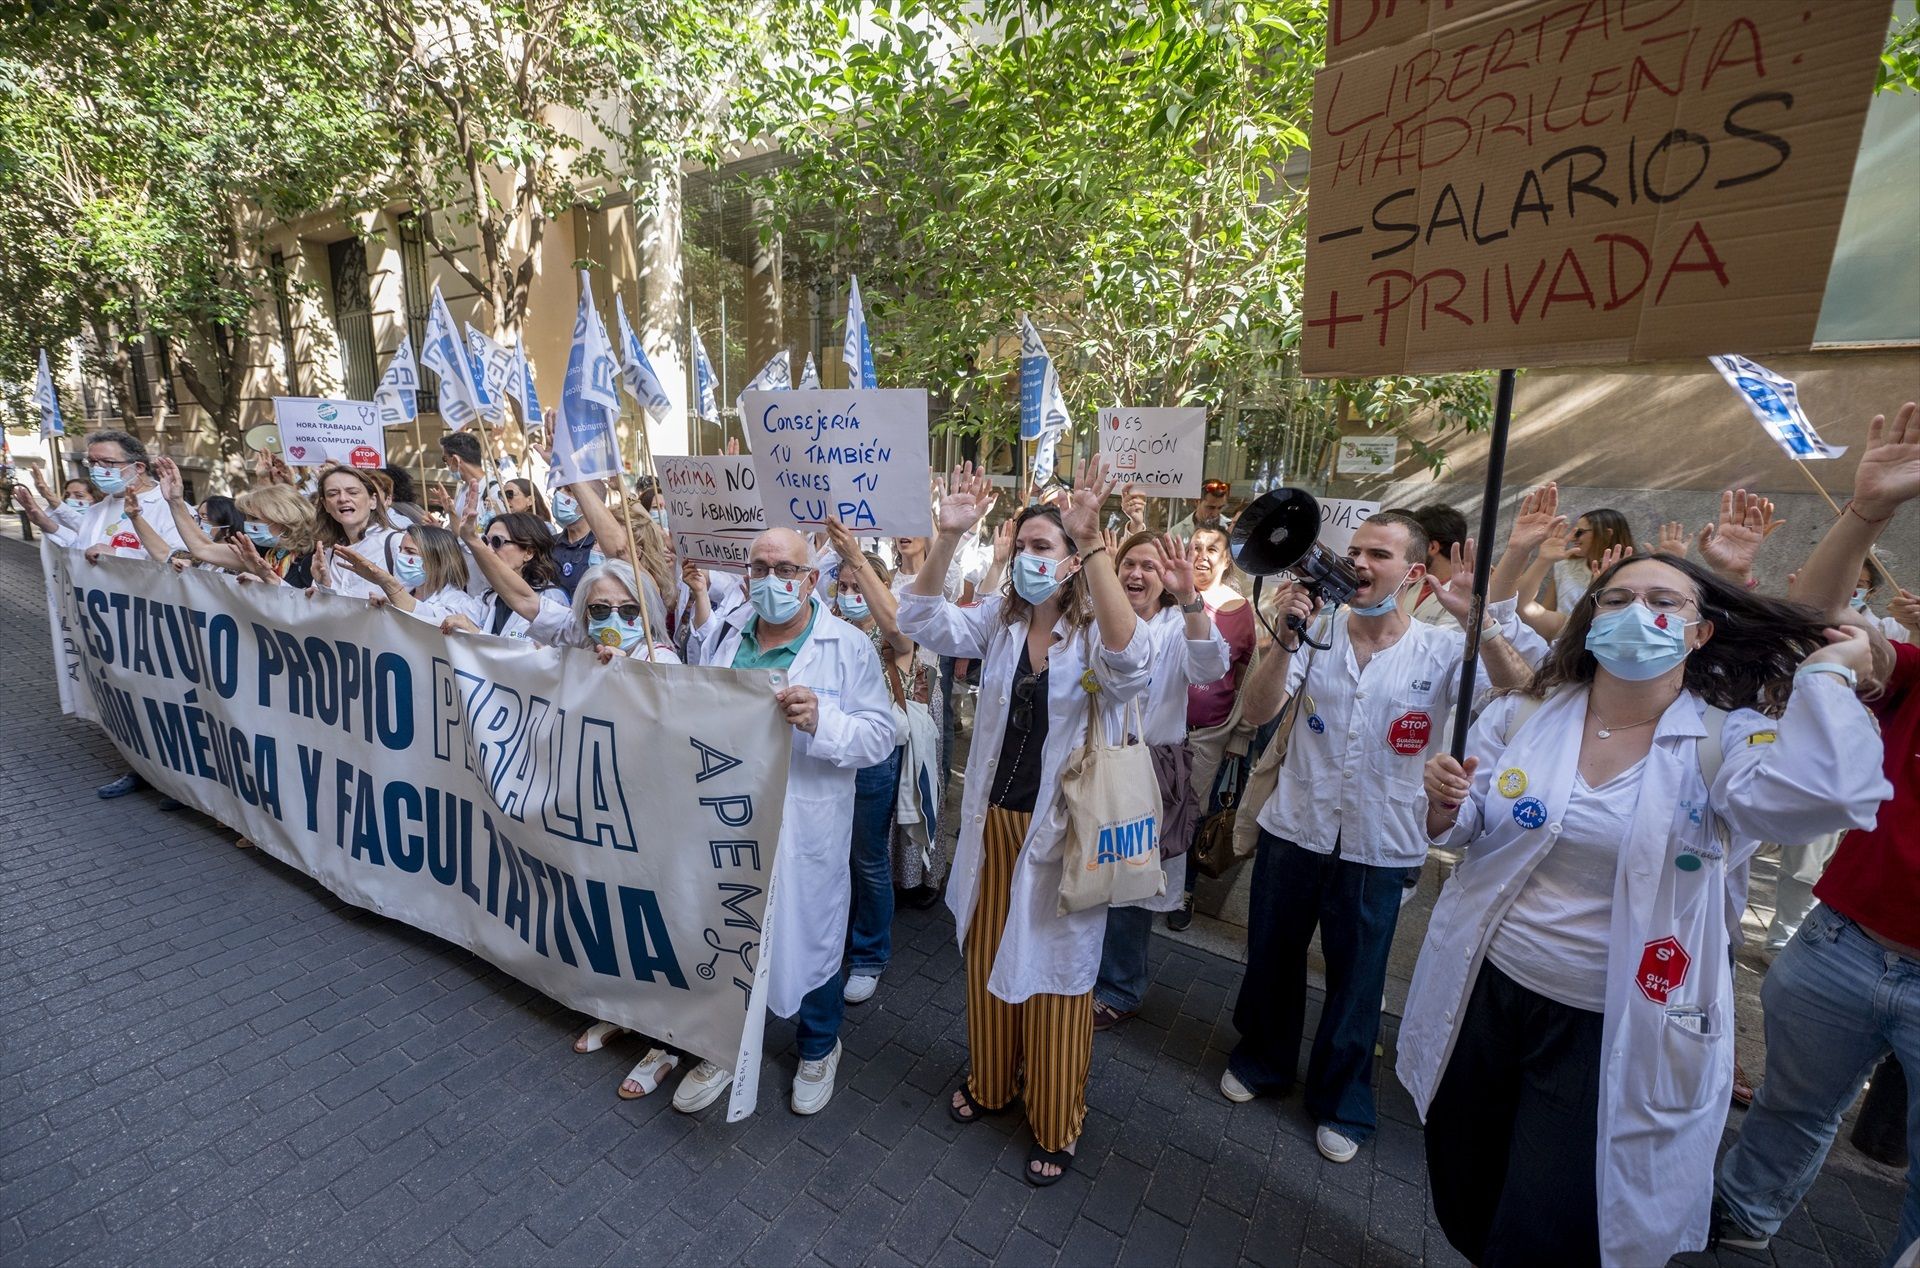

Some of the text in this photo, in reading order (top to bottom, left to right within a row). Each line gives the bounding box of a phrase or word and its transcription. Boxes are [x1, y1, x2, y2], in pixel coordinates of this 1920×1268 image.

[319, 423, 363, 432] TRABAJADA
[1125, 416, 1143, 431] ES
[317, 437, 367, 446] COMPUTADA
[1106, 432, 1178, 455] VOCACIÓN
[1120, 454, 1134, 465] ES
[725, 462, 755, 492] NO
[776, 468, 878, 492] TIENES TU
[671, 501, 694, 518] NOS
[118, 535, 136, 544] STOP
[73, 586, 239, 700] ESTATUTO
[251, 622, 414, 751] PROPIO
[541, 708, 639, 854] LA
[1400, 720, 1428, 730] STOP
[142, 687, 283, 824] MÉDICA
[297, 743, 323, 833] Y
[336, 757, 691, 991] FACULTATIVA
[1097, 816, 1157, 865] AMYT
